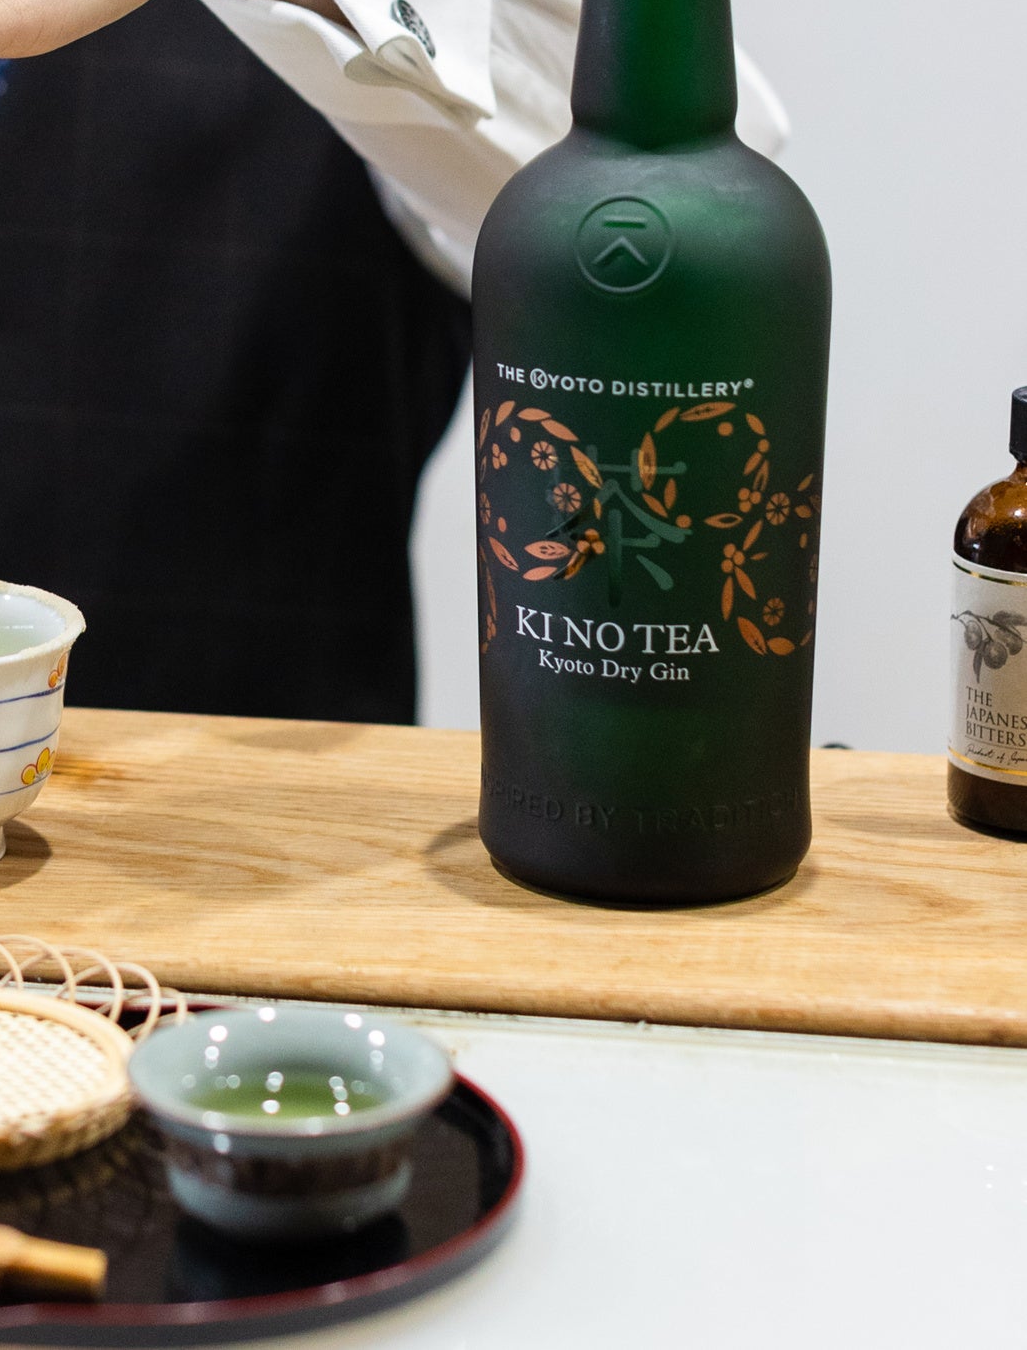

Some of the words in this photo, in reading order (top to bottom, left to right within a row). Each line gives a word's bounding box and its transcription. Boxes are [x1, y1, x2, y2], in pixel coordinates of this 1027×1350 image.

[496, 363, 525, 383] THE
[516, 605, 553, 643] KI
[562, 616, 625, 652] NO
[632, 623, 720, 654] TEA
[538, 649, 595, 675] Kyoto
[601, 659, 642, 684] Dry
[649, 662, 691, 681] Gin
[965, 686, 993, 708] THE
[966, 721, 1026, 748] BITTERS
